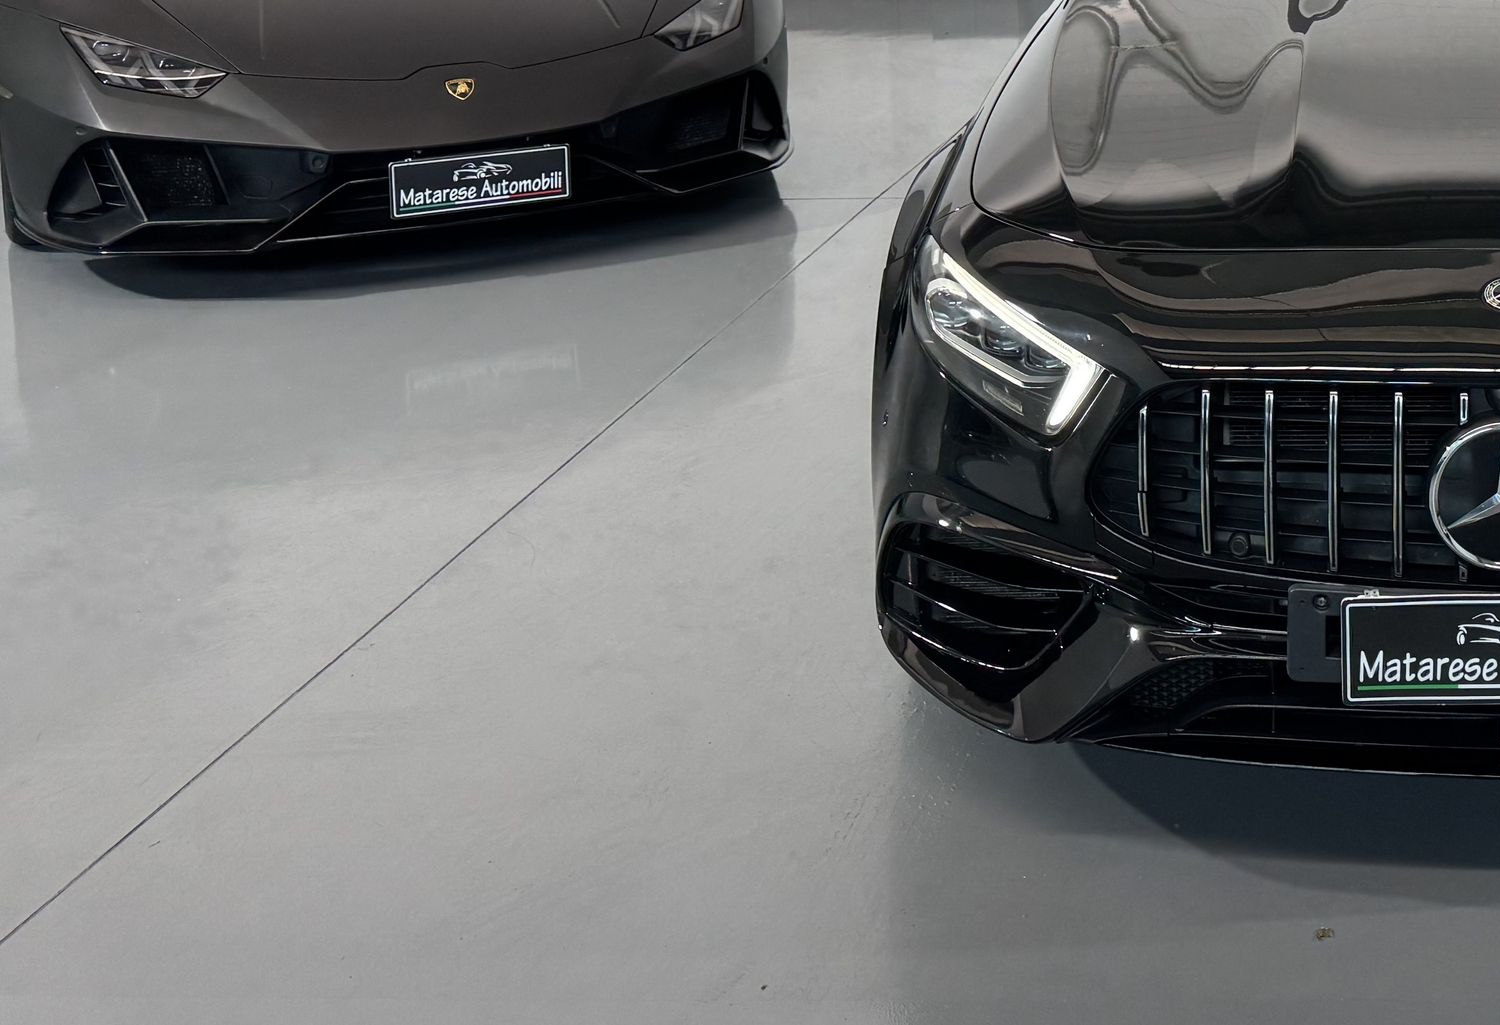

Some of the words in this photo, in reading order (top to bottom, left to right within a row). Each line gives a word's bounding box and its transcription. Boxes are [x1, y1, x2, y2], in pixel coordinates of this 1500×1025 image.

[399, 186, 477, 207] Matarese
[480, 171, 563, 197] Automobili
[1359, 650, 1498, 683] Matarese
